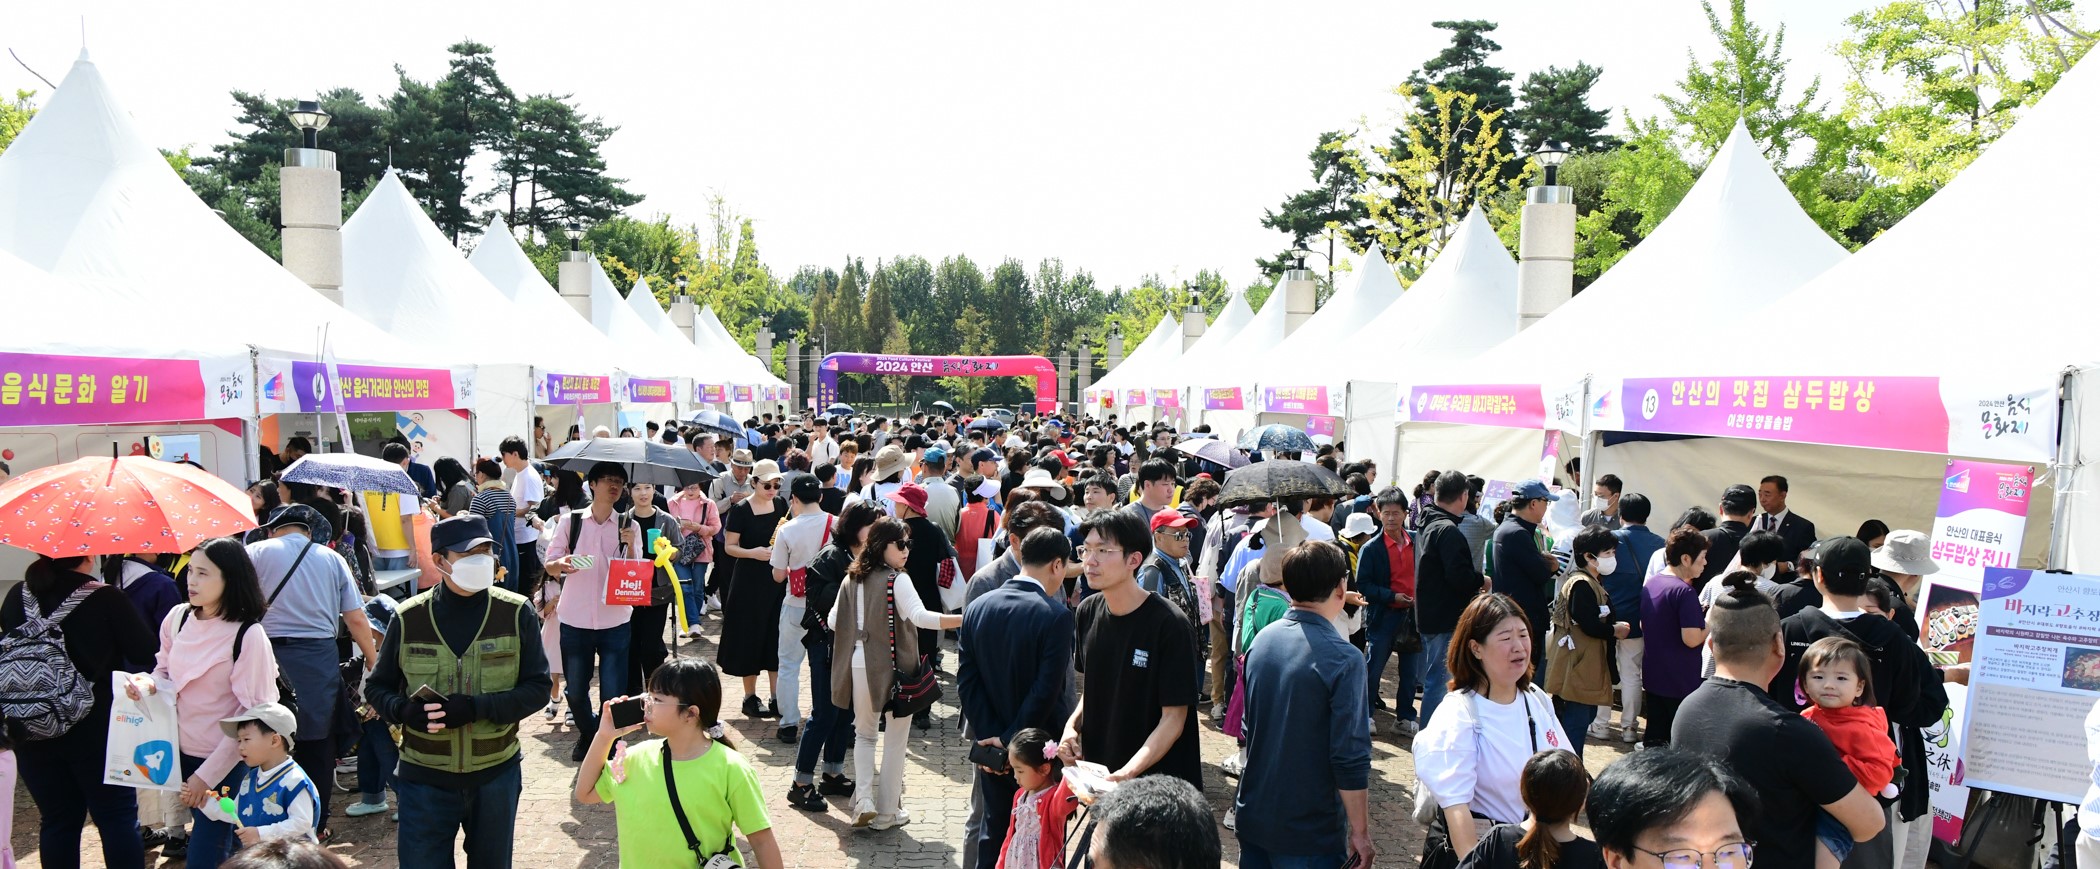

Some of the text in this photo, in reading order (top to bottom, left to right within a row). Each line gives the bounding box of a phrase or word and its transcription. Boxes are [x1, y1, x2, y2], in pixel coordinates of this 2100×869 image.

[876, 361, 908, 372] 2024
[911, 361, 934, 373] 안산
[1, 371, 148, 405] 음식문화 알기
[353, 377, 392, 398] 음식거리와
[393, 377, 415, 398] 안산의
[416, 378, 429, 398] 맛집
[1671, 380, 1875, 413] 안산의 맛집 삼두밥상
[1644, 395, 1656, 413] 13
[1946, 525, 2002, 545] 안산의 대표음식
[1932, 540, 2011, 568] 삼두밥상 전시
[615, 588, 645, 596] Denmark
[620, 579, 642, 591] Hej!
[2057, 585, 2100, 597] 안산시 향토
[1926, 747, 1951, 771] 之休
